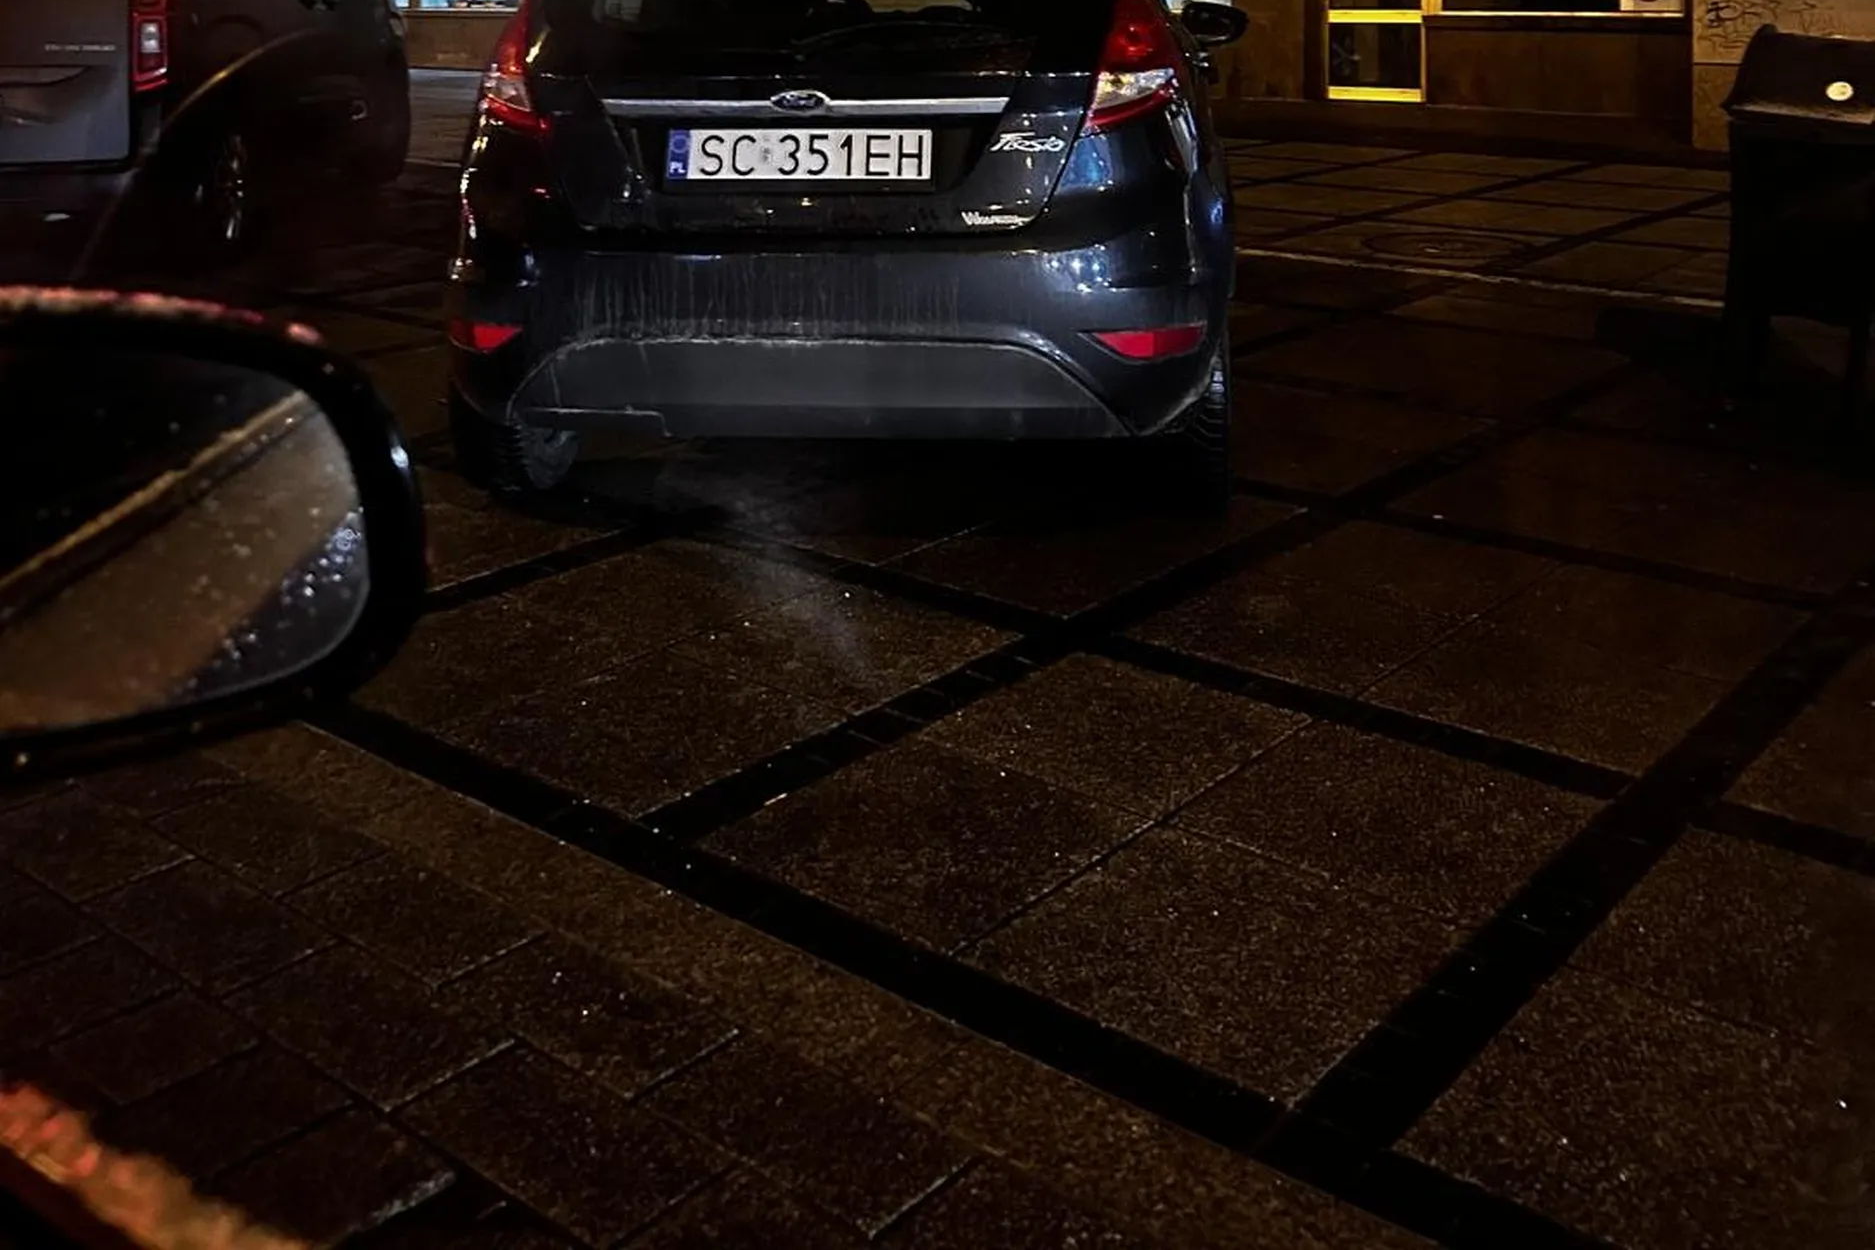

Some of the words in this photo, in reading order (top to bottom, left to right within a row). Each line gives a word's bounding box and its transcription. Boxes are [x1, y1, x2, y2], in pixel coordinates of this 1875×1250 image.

[990, 131, 1066, 152] Fiesta
[699, 134, 757, 177] SC
[777, 134, 924, 177] 351EH
[669, 161, 686, 175] PL
